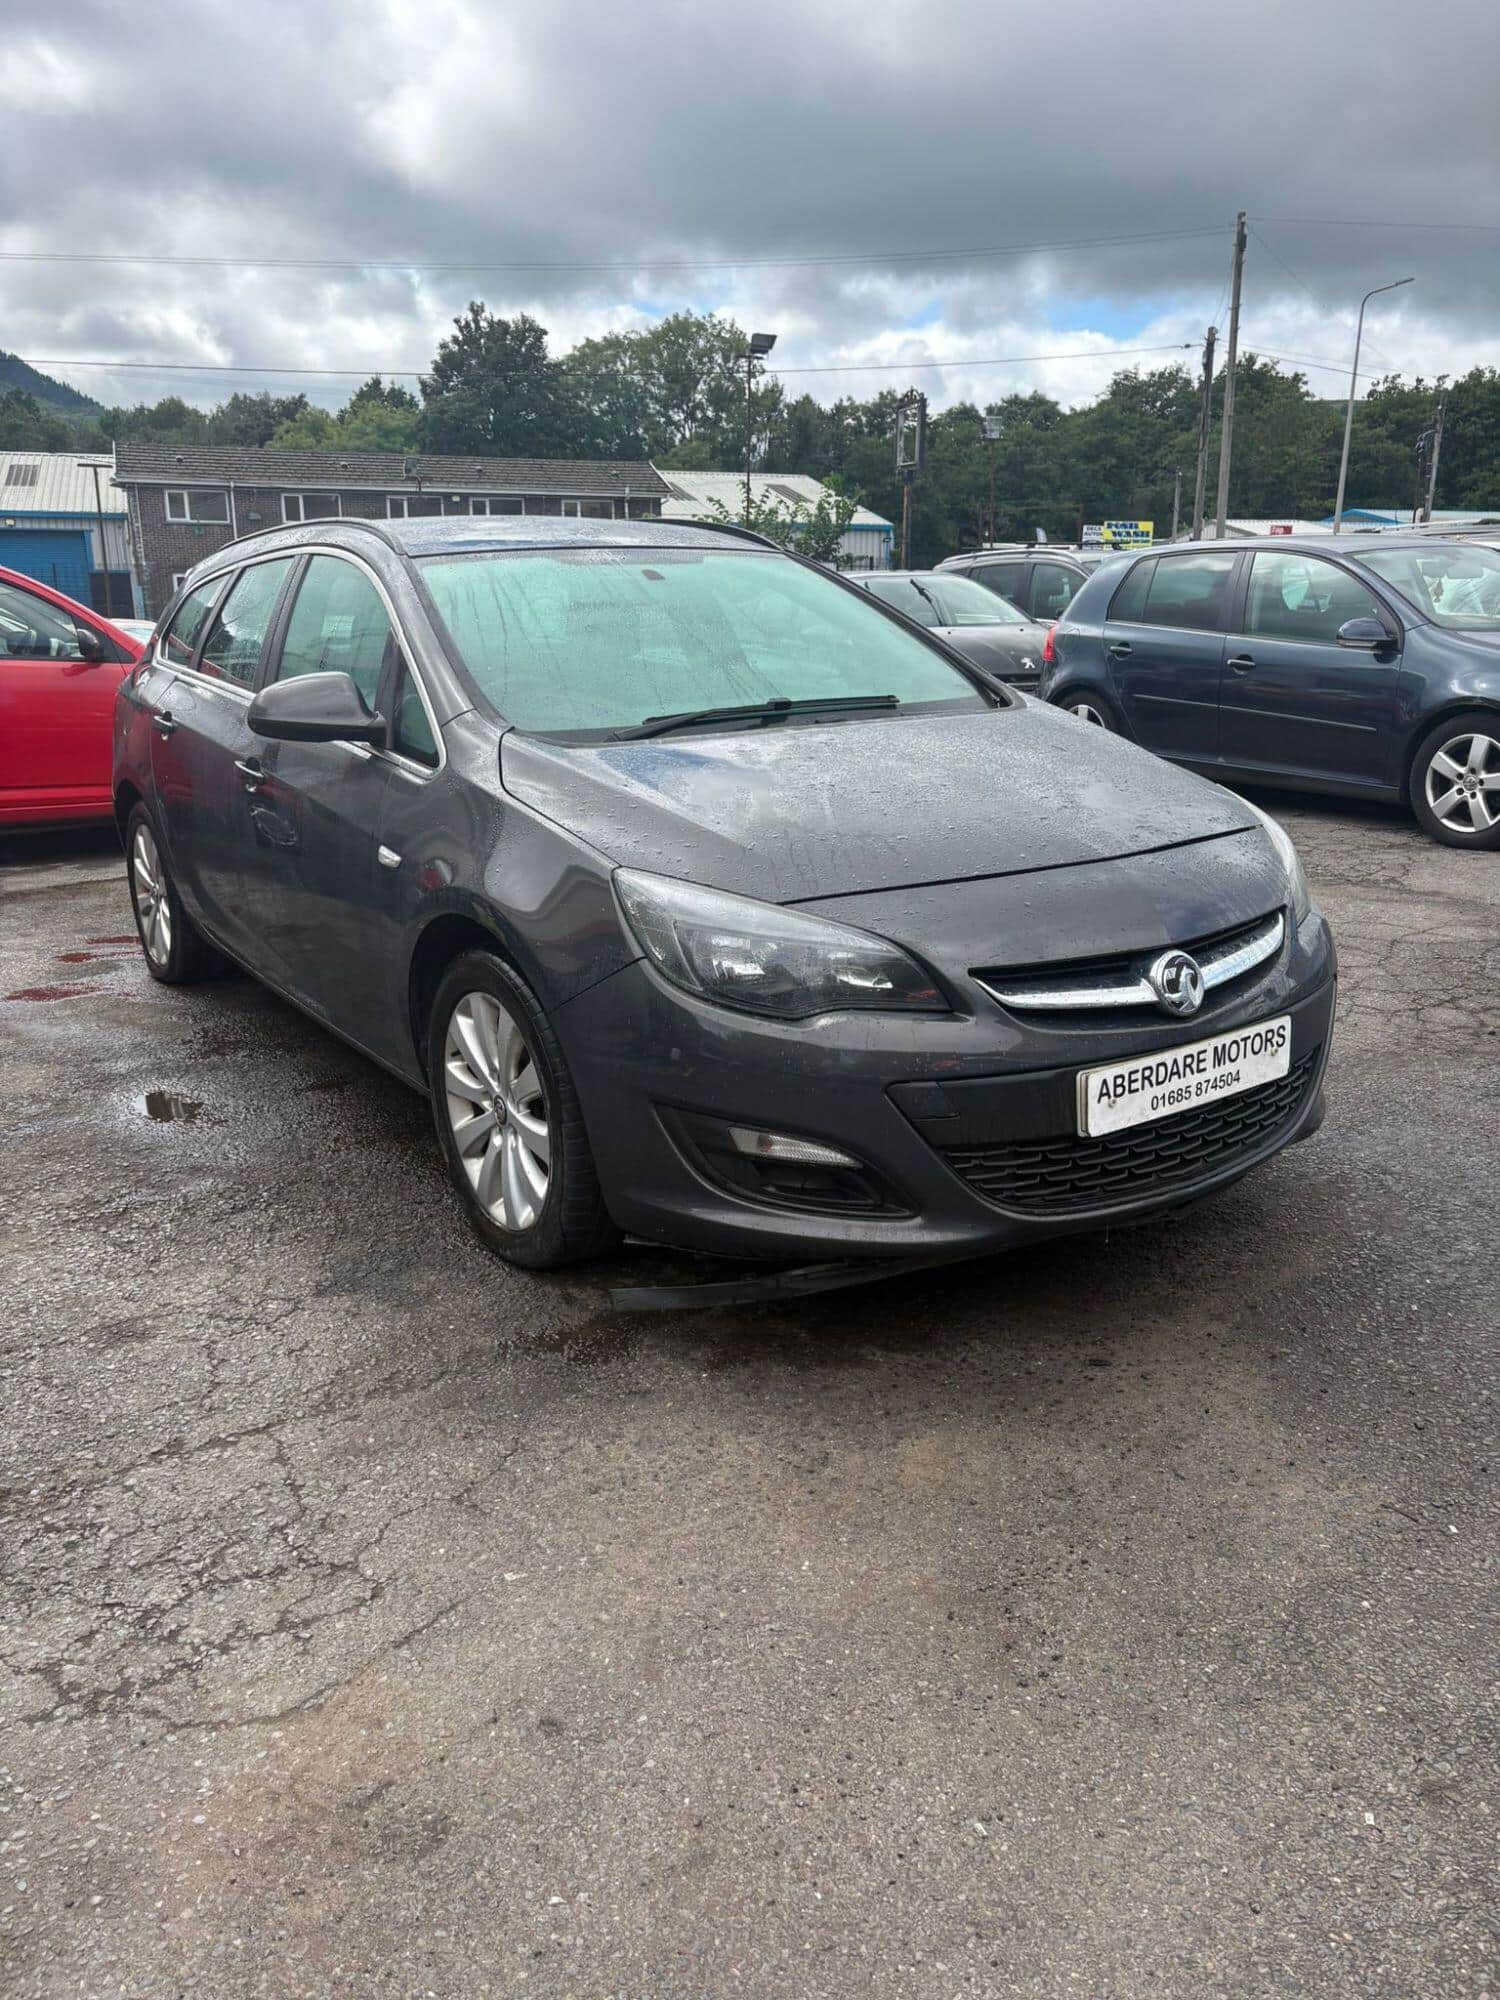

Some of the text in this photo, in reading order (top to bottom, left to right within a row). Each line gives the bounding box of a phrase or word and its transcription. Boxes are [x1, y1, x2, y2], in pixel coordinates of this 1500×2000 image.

[1097, 1025, 1287, 1104] ABERDARE MOTORS
[1150, 1070, 1241, 1111] 01685 874504
